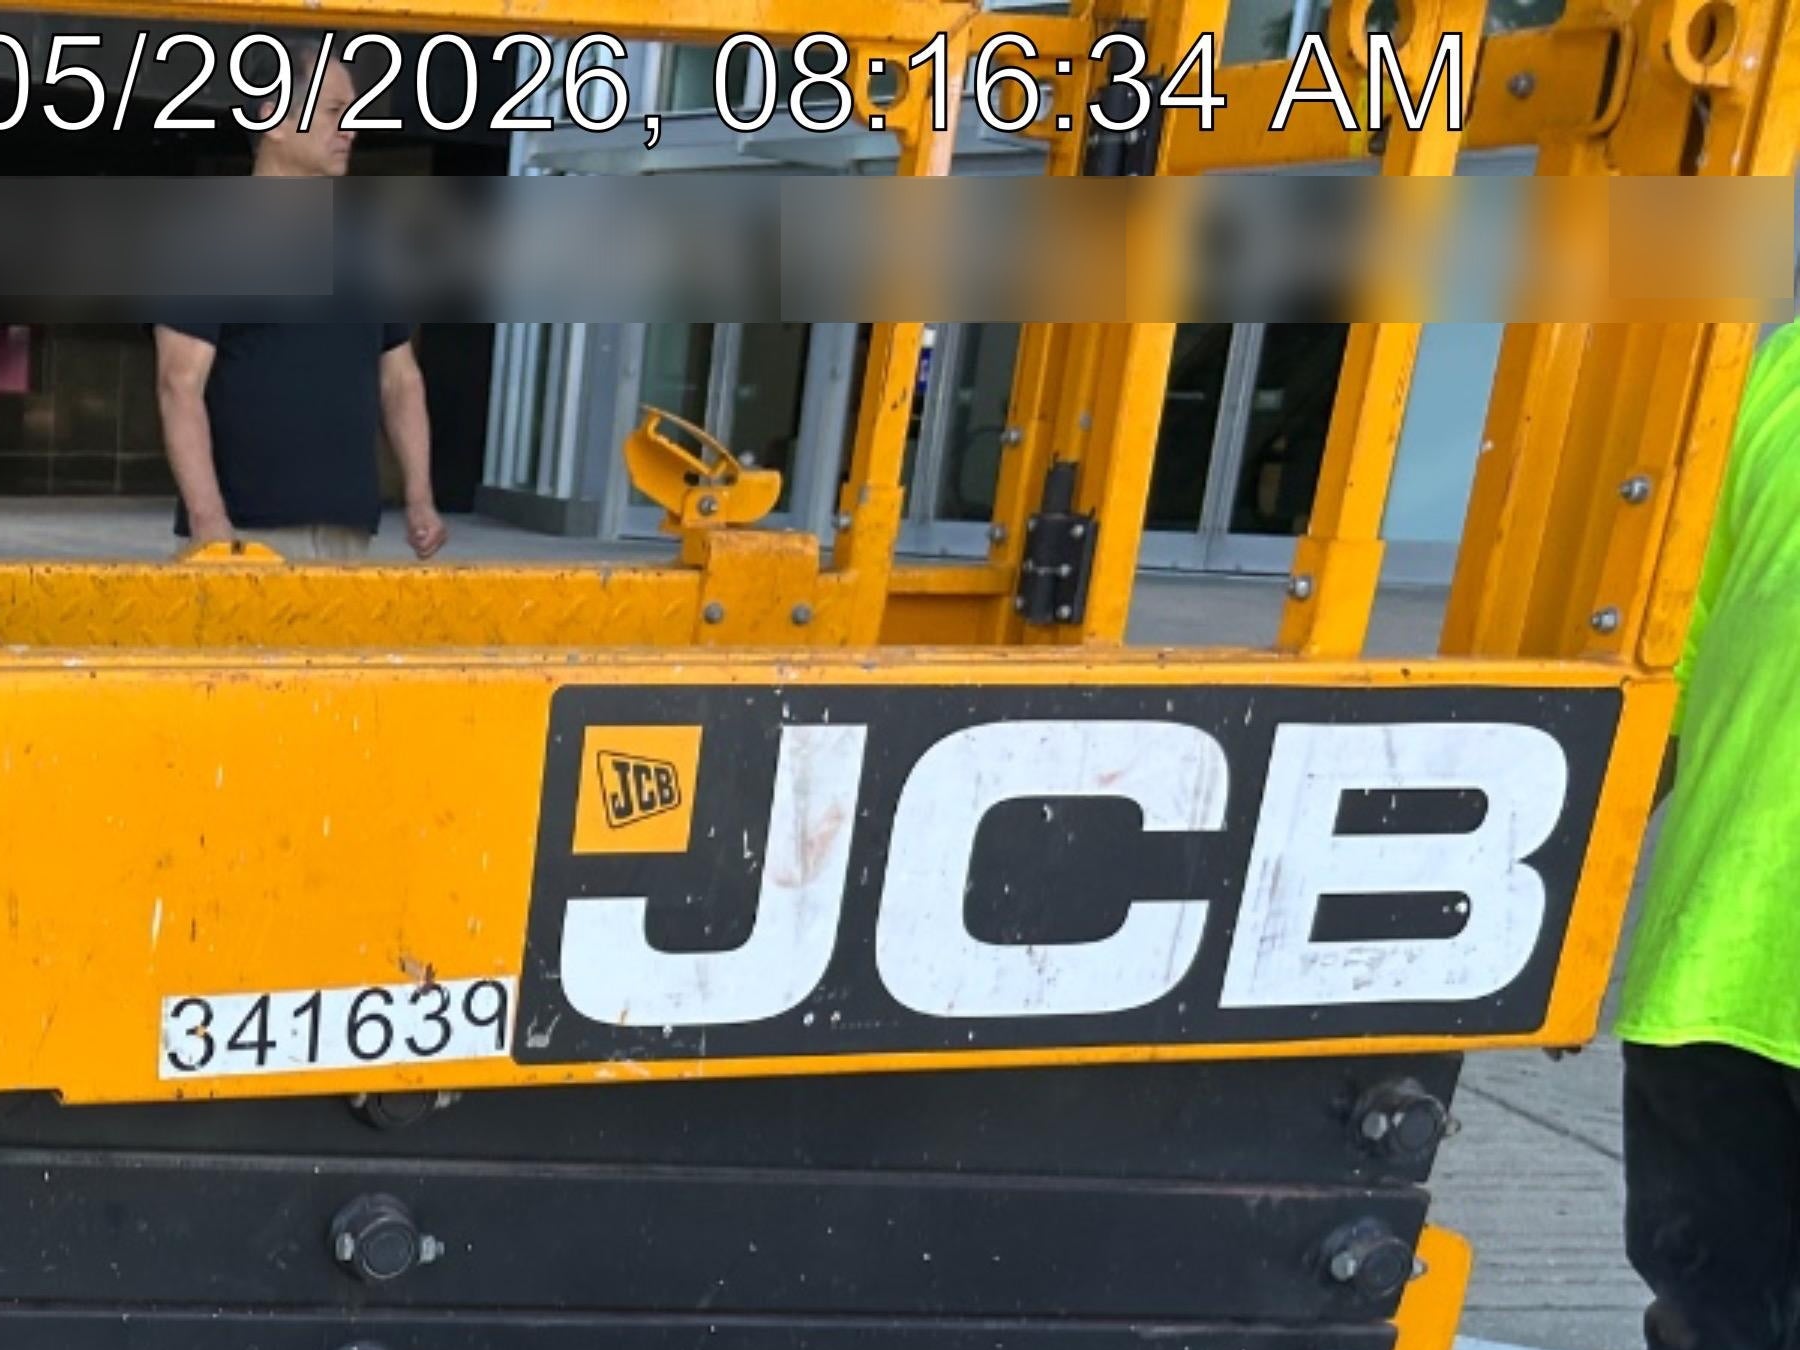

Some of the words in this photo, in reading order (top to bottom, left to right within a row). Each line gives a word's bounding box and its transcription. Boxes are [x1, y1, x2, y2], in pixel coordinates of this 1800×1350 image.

[606, 757, 678, 820] JCB
[558, 719, 1569, 1027] JCB
[166, 979, 510, 1071] 341639
